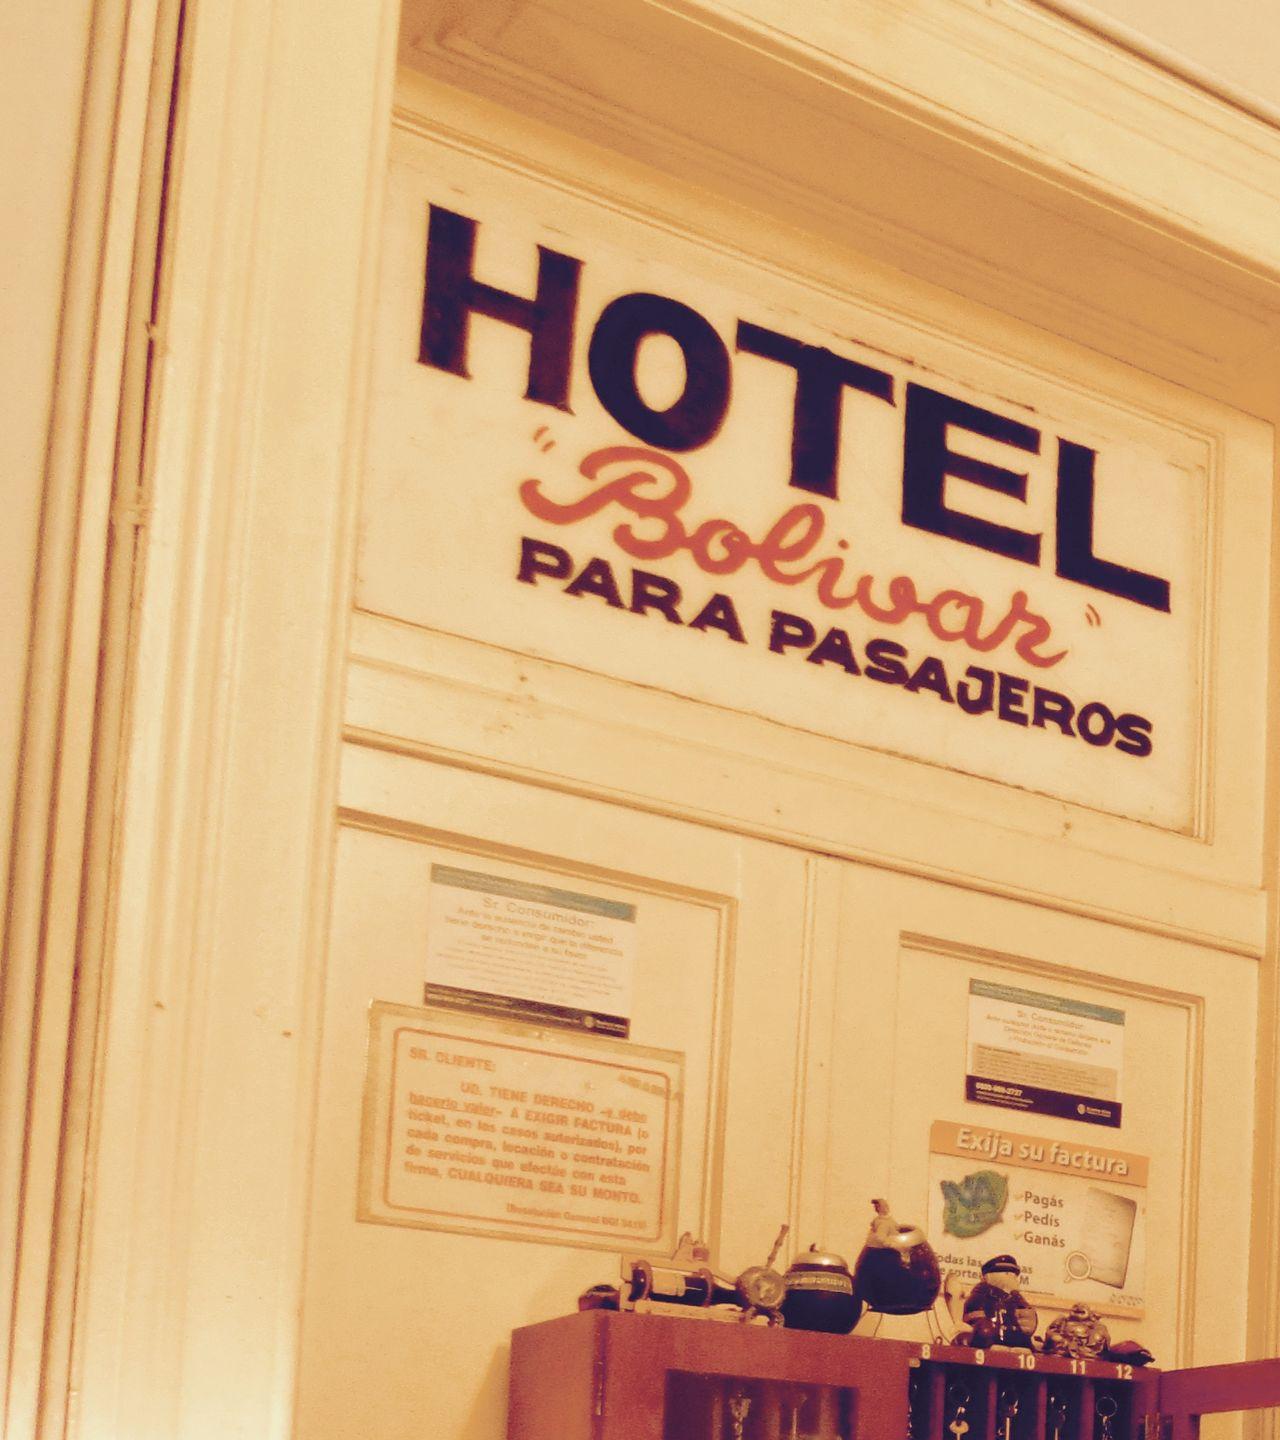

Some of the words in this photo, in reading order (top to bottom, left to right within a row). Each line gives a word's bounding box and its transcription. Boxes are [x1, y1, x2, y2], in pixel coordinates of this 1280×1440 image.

[417, 203, 1172, 613] HOTEL
[517, 536, 748, 643] PARA
[769, 608, 1154, 757] PASAJEROS
[490, 1085, 527, 1103] TIENE
[533, 1092, 594, 1114] DERECHO
[407, 1128, 439, 1142] cada
[525, 1109, 568, 1126] EXIGIR
[574, 1116, 632, 1136] FACTURA
[502, 1125, 538, 1140] casos
[627, 1143, 648, 1157] por
[956, 1127, 1013, 1160] Exija
[1018, 1141, 1045, 1162] su
[1050, 1142, 1129, 1176] factura
[405, 1144, 422, 1156] de
[427, 1148, 486, 1166] servicios
[491, 1158, 516, 1173] que
[572, 1170, 595, 1182] con
[599, 1173, 627, 1186] esta
[448, 1167, 534, 1191] CUALQUIERA
[539, 1180, 564, 1195] SEA
[570, 1184, 588, 1197] SU
[592, 1187, 641, 1204] MONTO.
[1024, 1190, 1064, 1210] Pagás
[1024, 1210, 1061, 1228] Pedís
[1023, 1231, 1066, 1249] Ganás
[937, 1254, 965, 1267] odas
[922, 1344, 931, 1359] 8
[975, 1349, 985, 1365] 9
[1018, 1354, 1036, 1371] 10
[1070, 1360, 1087, 1375] 11
[1116, 1364, 1133, 1380] 12
